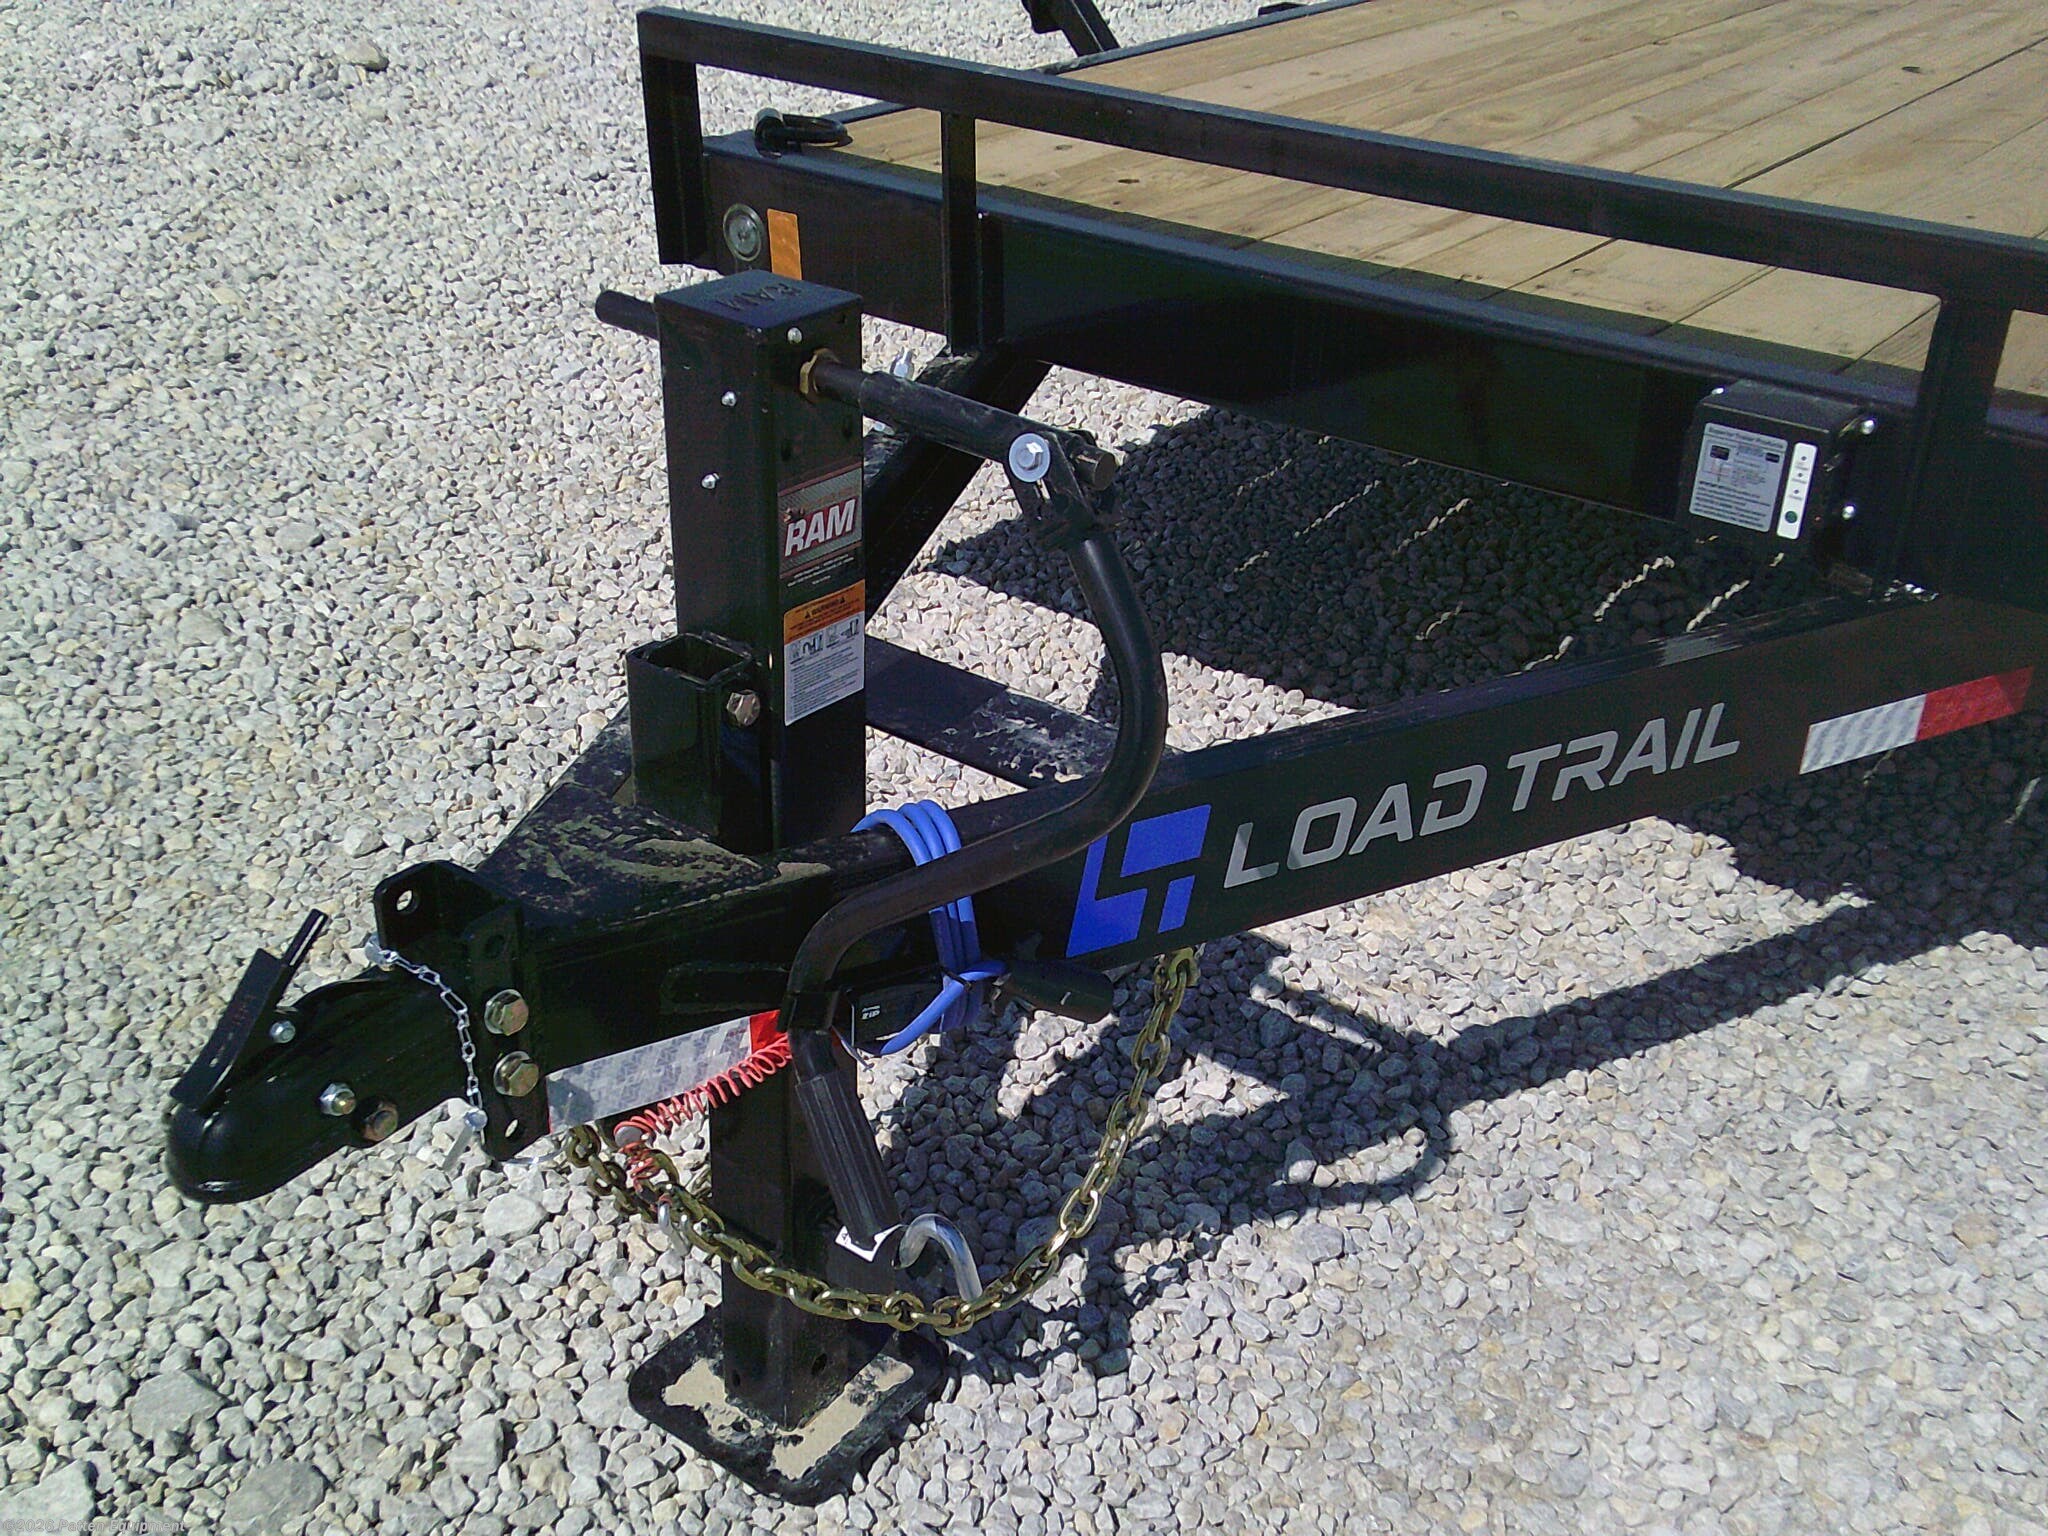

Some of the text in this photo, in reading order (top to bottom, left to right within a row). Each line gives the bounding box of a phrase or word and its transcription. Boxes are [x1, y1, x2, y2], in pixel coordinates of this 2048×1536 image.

[784, 498, 856, 557] RAM
[1223, 703, 1741, 889] LOAD TRAIL
